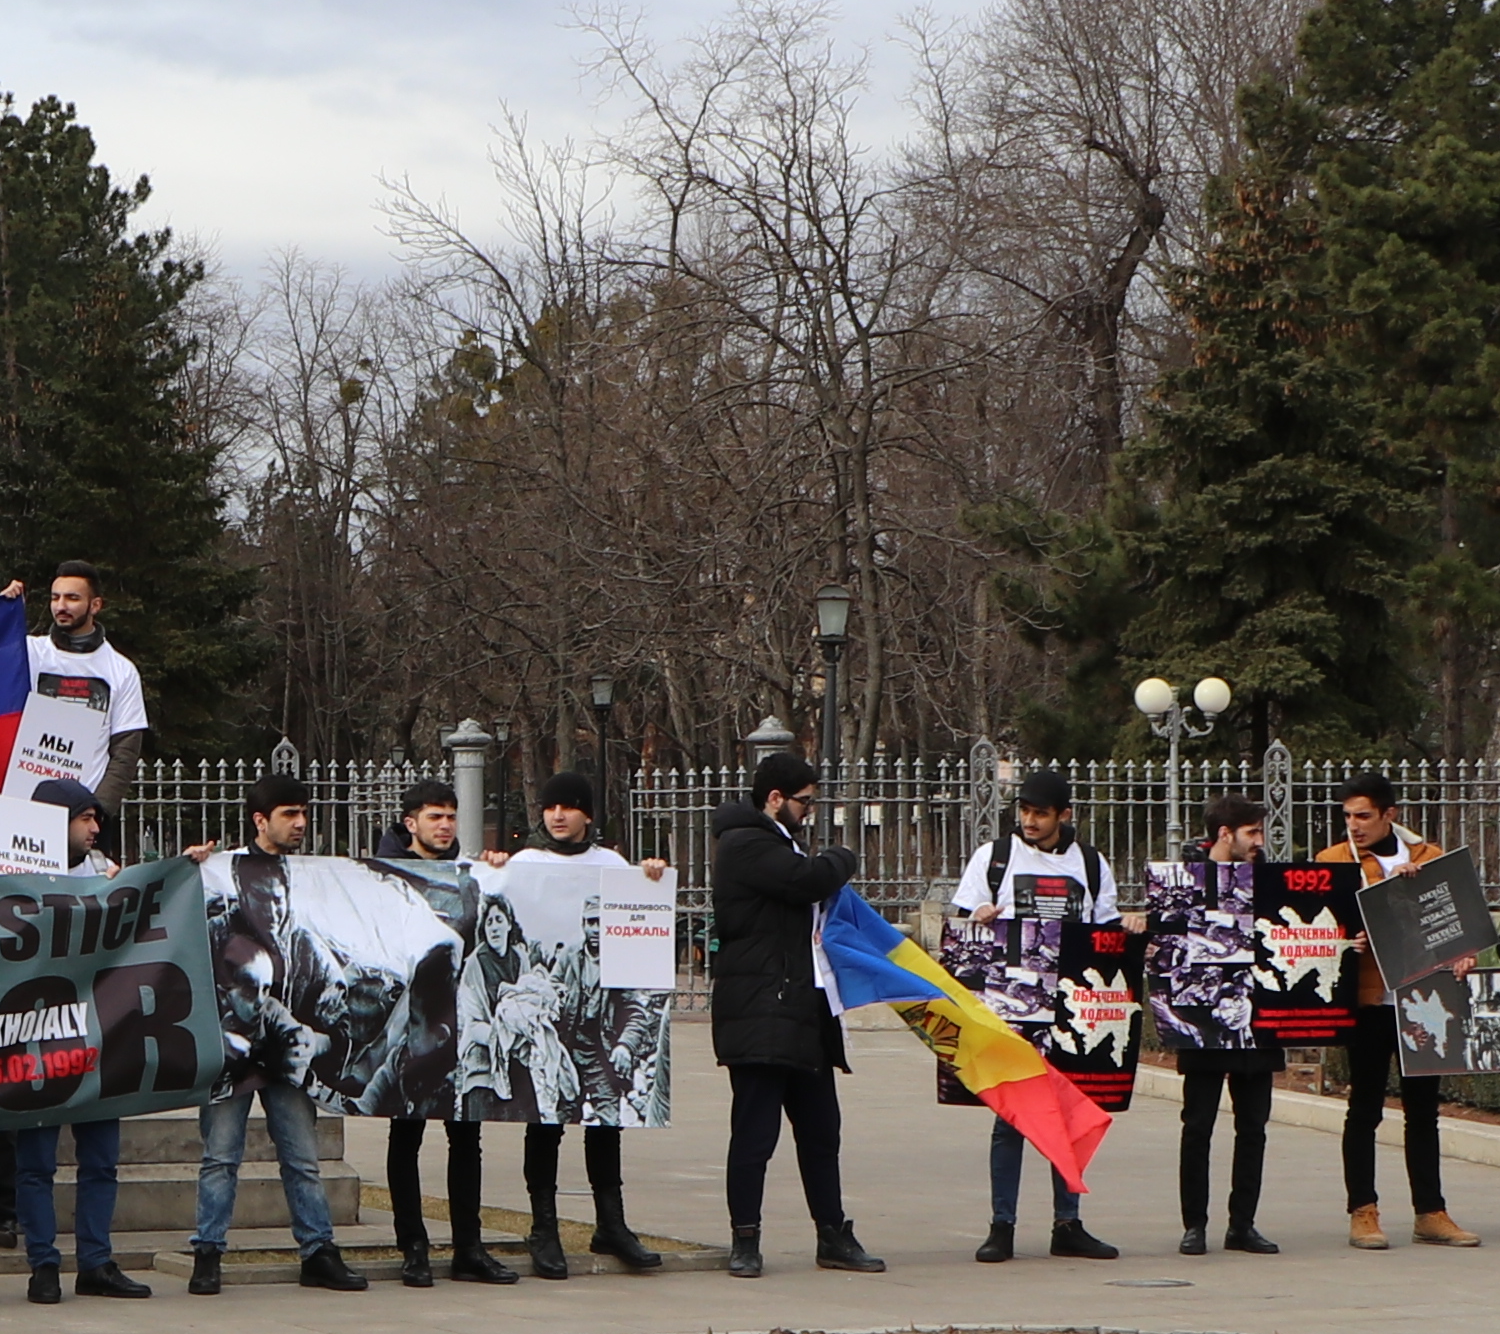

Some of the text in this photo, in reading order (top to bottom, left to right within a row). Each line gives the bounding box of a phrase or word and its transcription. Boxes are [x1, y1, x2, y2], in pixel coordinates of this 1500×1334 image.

[38, 732, 75, 755] МЫ
[21, 747, 83, 771] НЕ ЗАБУДЕМ
[11, 834, 45, 855] МЫ
[13, 853, 60, 870] ЗАБУДЕМ
[1283, 869, 1333, 892] 1992
[603, 902, 673, 912] СПРАВЕДЛИВОСТЬ
[629, 914, 646, 922] ДЛЯ
[605, 925, 670, 937] ХОДЖАЛЫ
[1270, 925, 1346, 940] ОБРЕЧЕННЫЙ
[1091, 930, 1127, 953] 1992
[1279, 945, 1338, 957] ХОДЖАЛЫ
